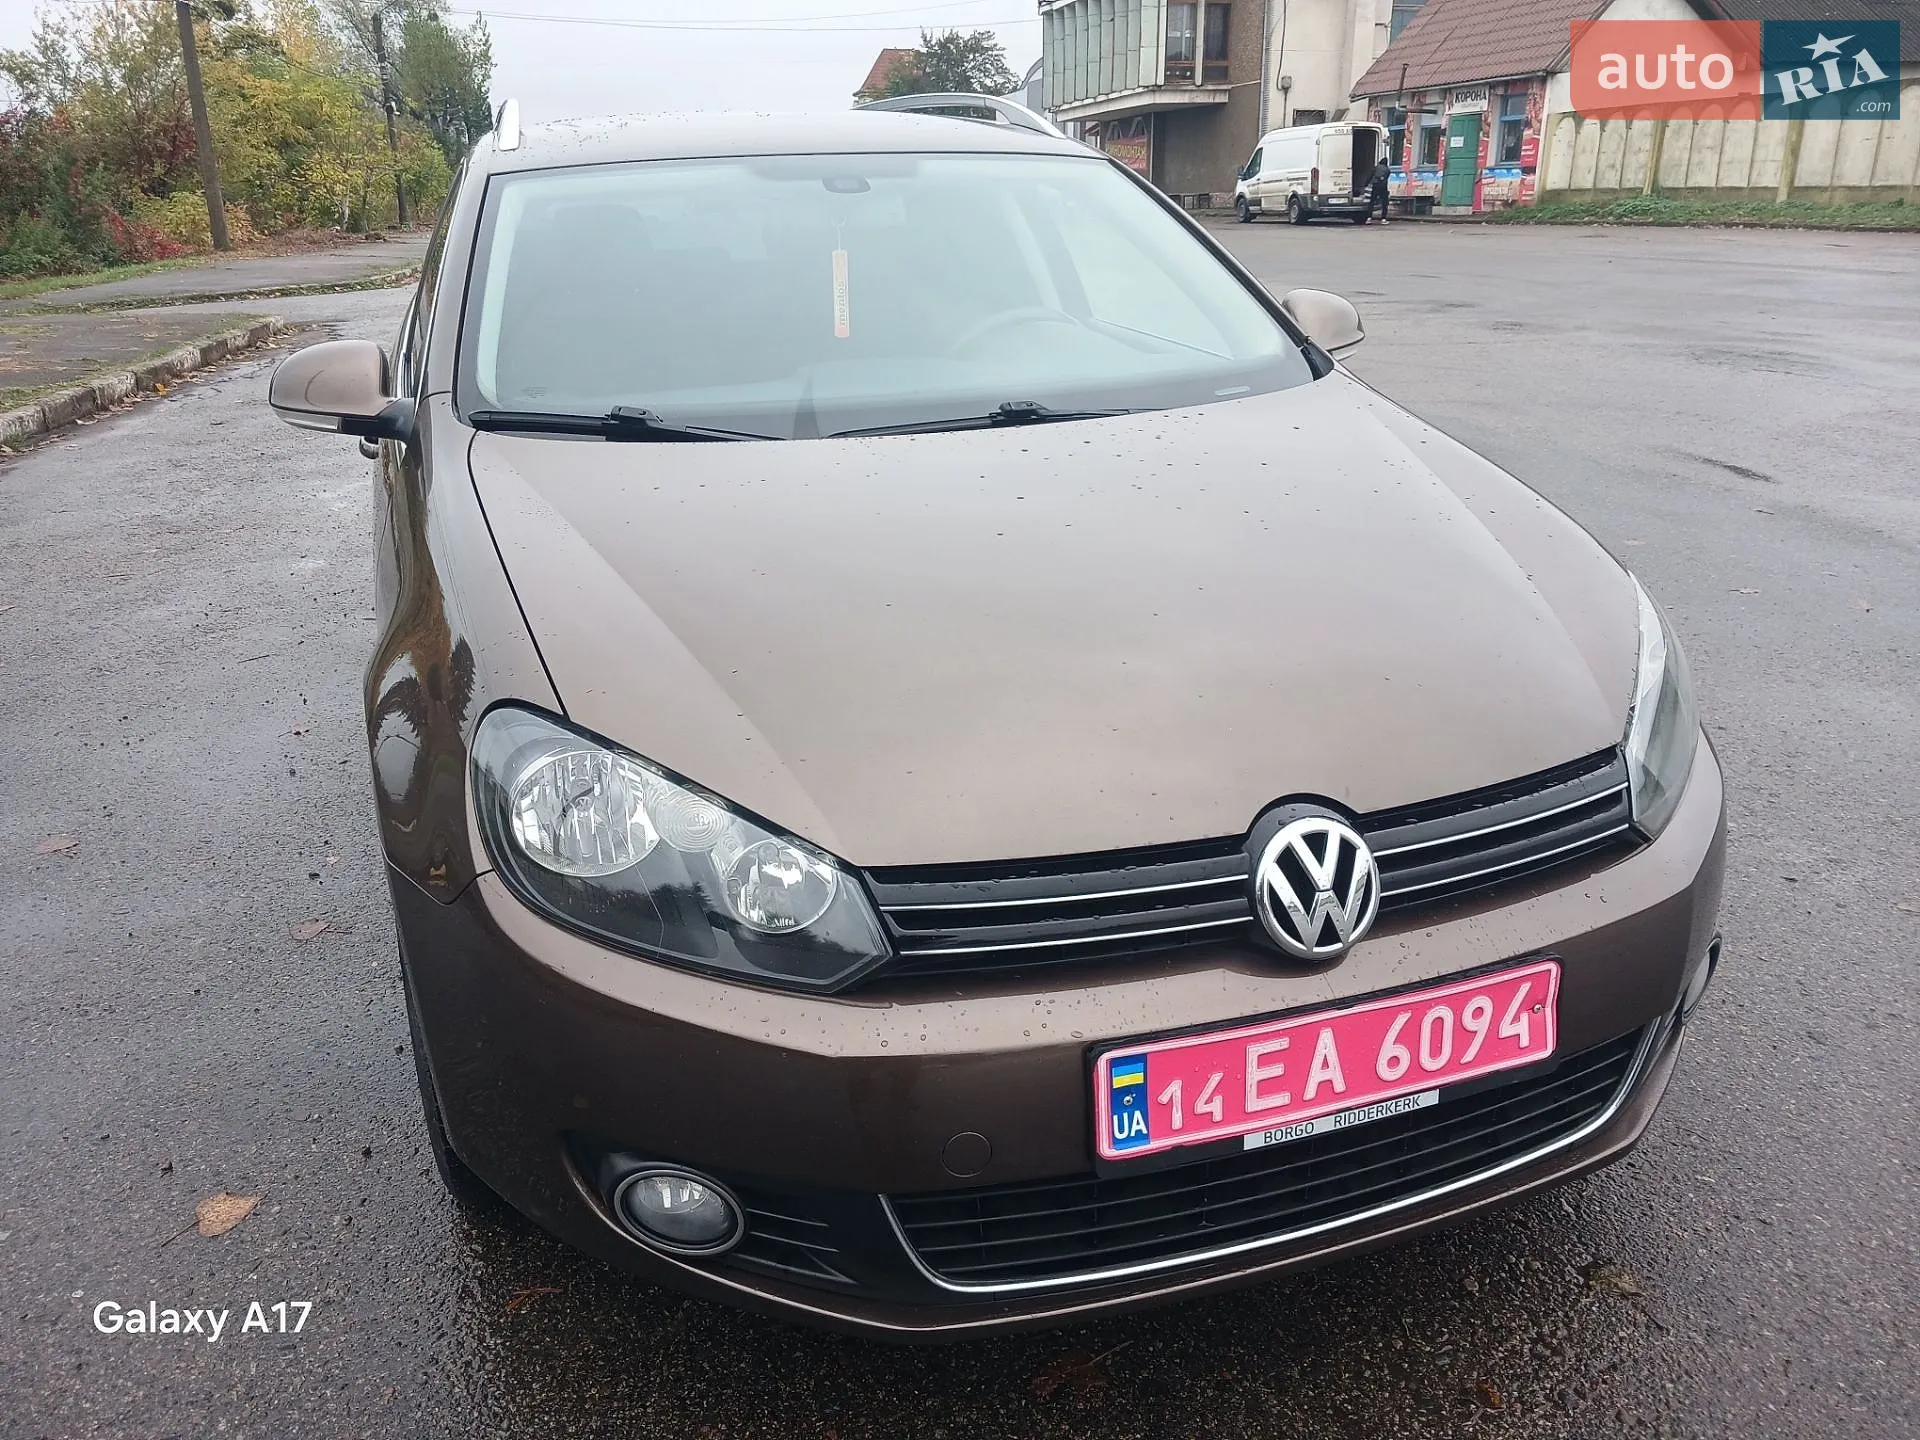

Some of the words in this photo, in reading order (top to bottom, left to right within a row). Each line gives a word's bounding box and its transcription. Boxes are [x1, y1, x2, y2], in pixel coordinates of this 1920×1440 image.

[1454, 88, 1488, 104] КОРОНА
[1157, 1071, 1224, 1131] 14
[1244, 1027, 1347, 1114] EA
[1375, 981, 1533, 1083] 6094
[1112, 1110, 1148, 1140] UA
[1263, 1121, 1315, 1145] BORGO
[1332, 1095, 1421, 1129] RIDDERKERK
